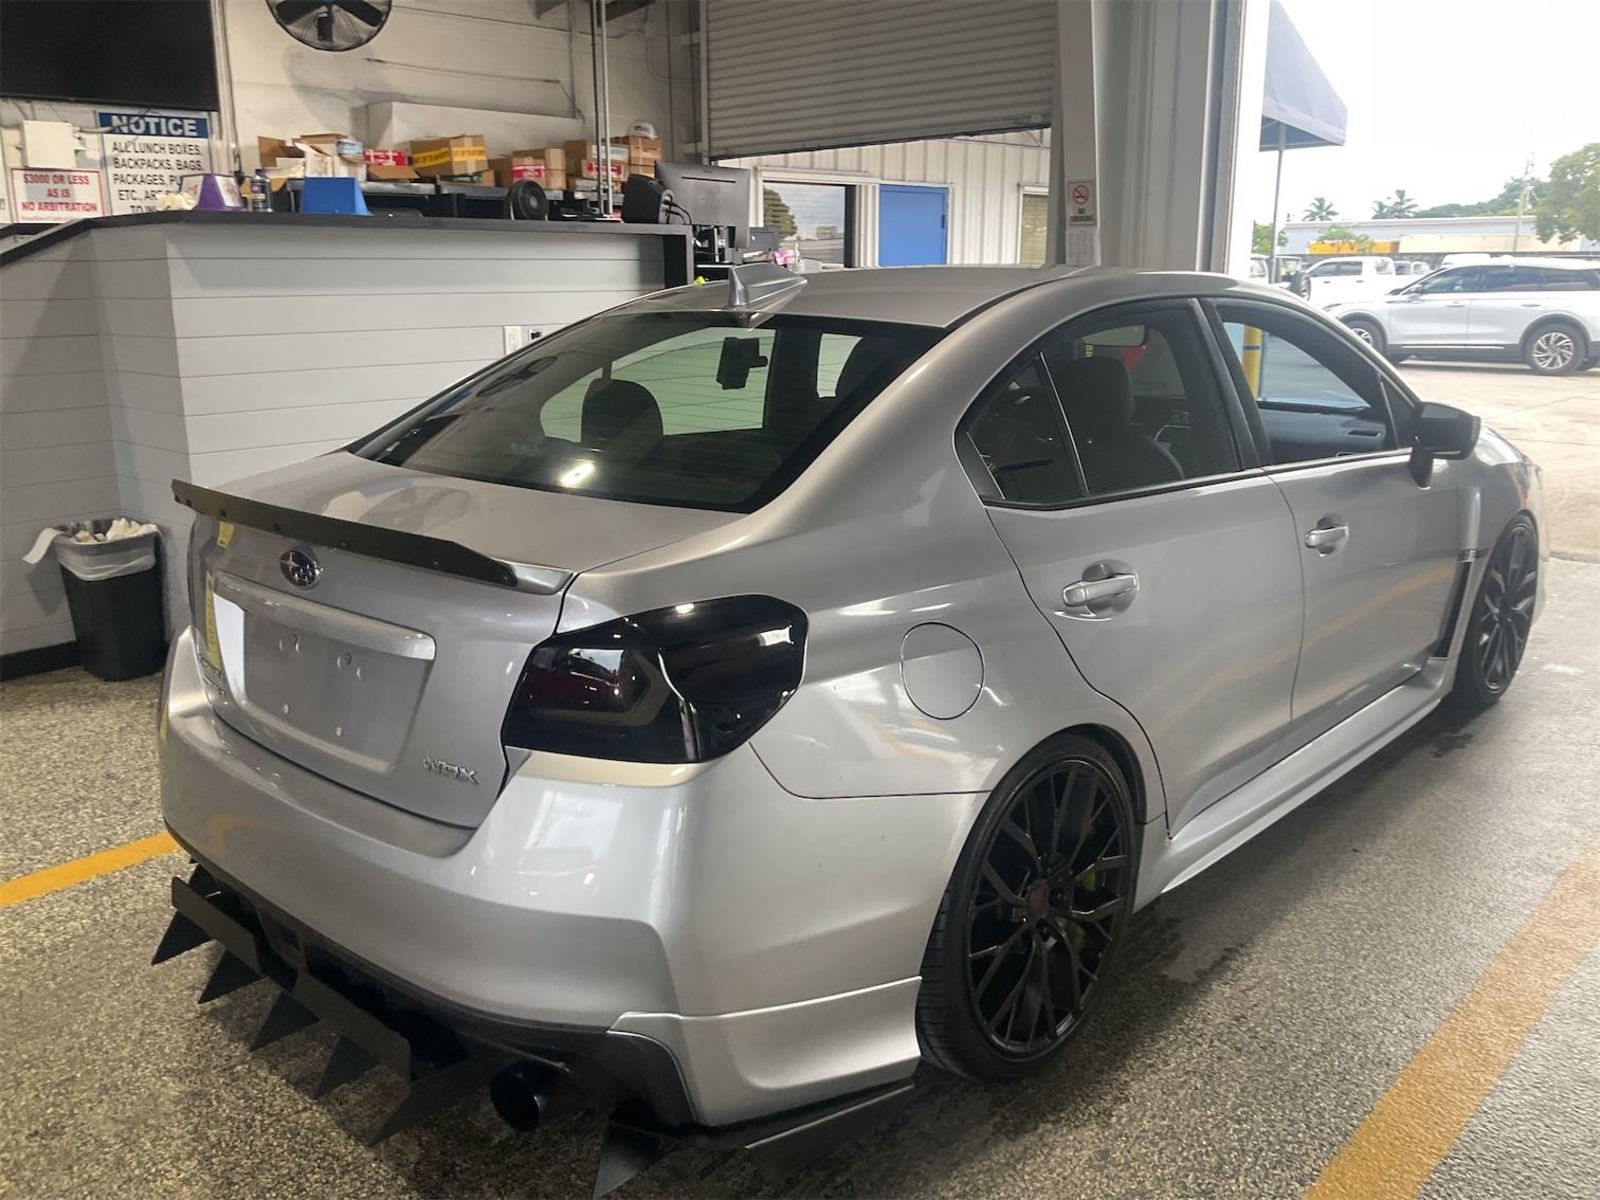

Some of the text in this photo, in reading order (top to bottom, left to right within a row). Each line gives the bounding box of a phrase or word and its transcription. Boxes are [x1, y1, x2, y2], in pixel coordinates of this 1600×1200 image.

[111, 115, 198, 136] NOTICE
[112, 141, 131, 153] ALL
[133, 143, 167, 154] LUNCH
[52, 174, 66, 184] OR
[68, 174, 90, 185] LESS
[47, 188, 71, 198] AS IS
[21, 201, 98, 213] NO ARBITRATION
